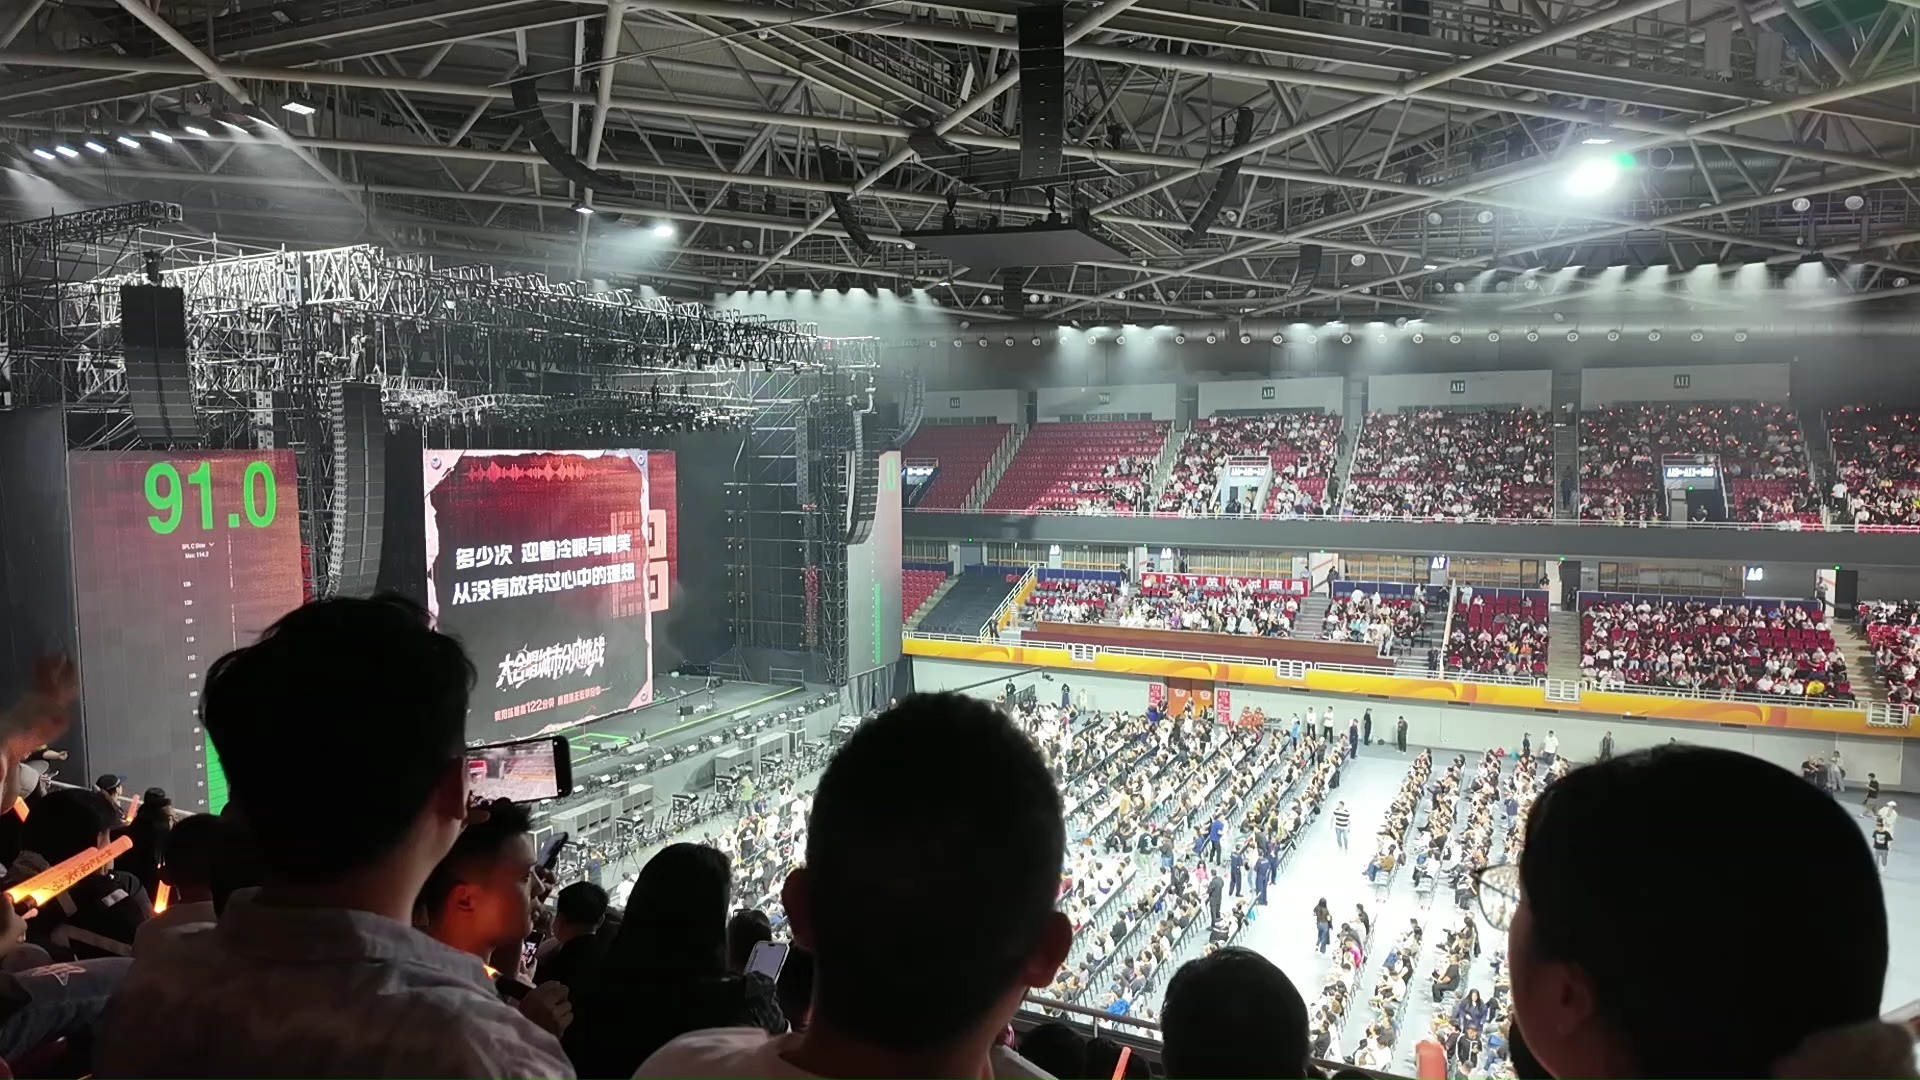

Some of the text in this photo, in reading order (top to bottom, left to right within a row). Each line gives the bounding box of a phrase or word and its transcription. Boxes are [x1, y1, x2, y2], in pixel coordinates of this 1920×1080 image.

[1451, 383, 1465, 392] A12
[1675, 376, 1689, 386] A11
[144, 462, 277, 533] 91.0
[455, 534, 632, 570] 多少次 迎着冷眼与嘲笑
[1431, 556, 1446, 569] A7
[452, 563, 635, 604] 从没有放弃过心中的理想
